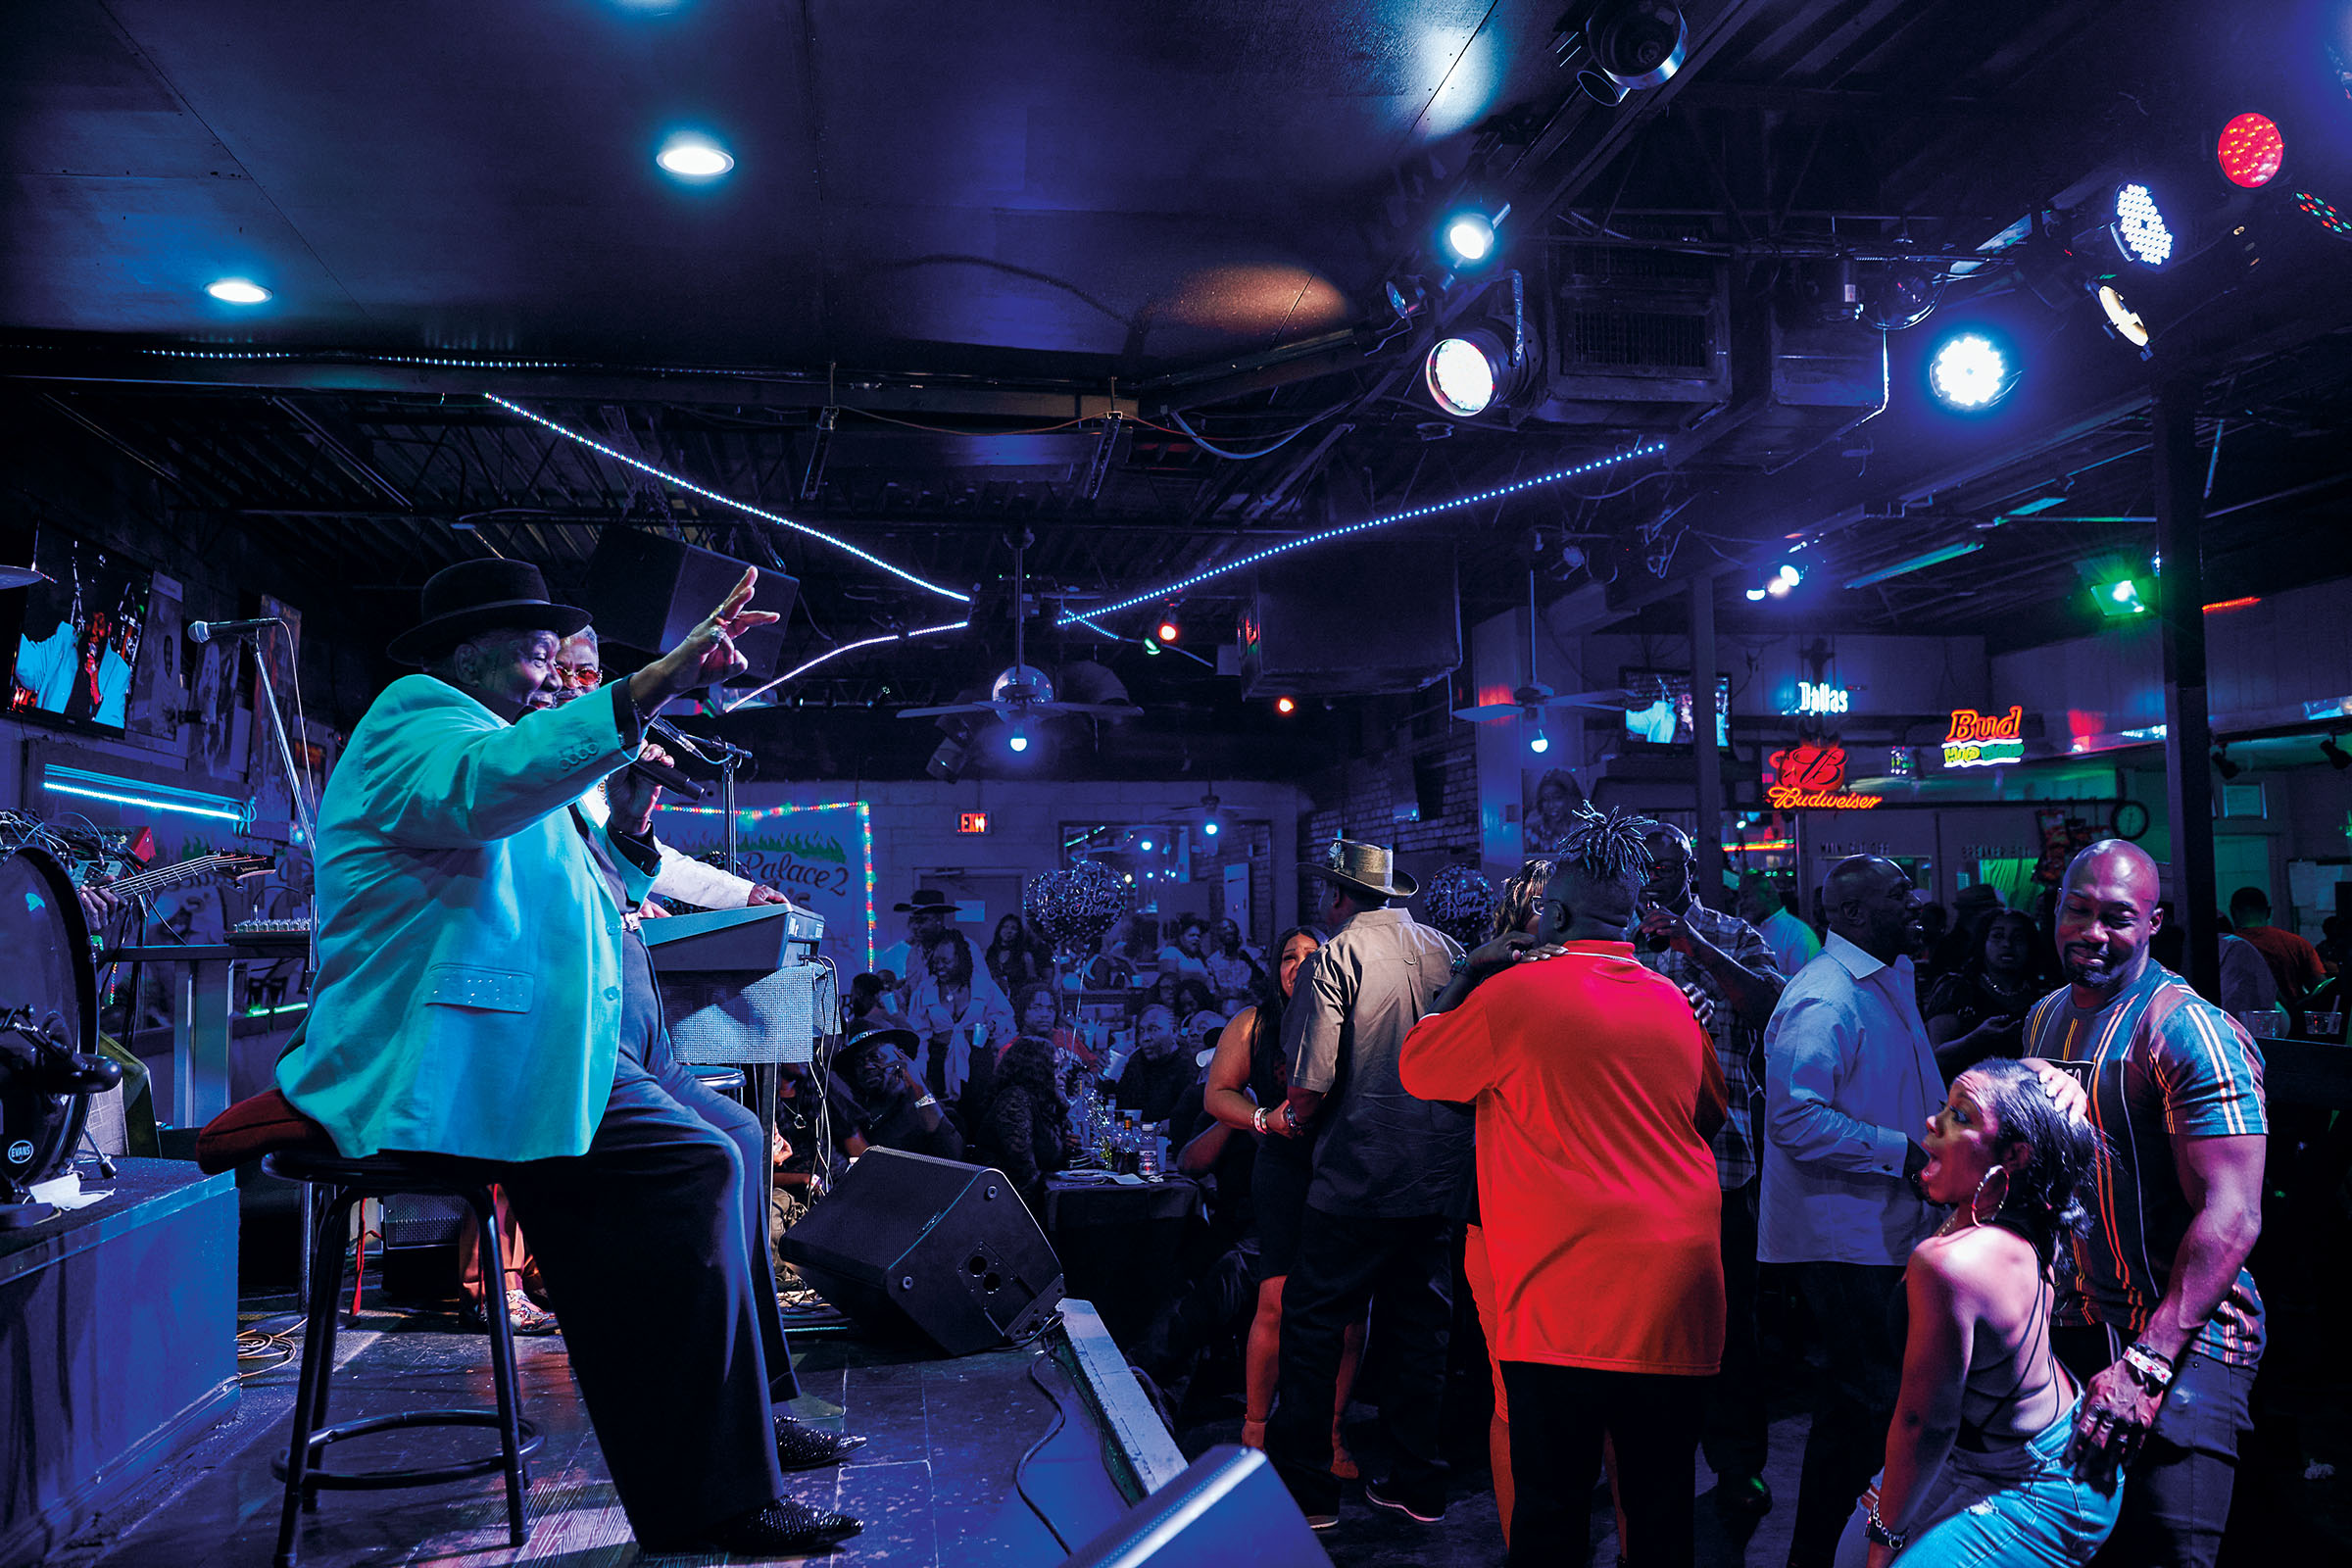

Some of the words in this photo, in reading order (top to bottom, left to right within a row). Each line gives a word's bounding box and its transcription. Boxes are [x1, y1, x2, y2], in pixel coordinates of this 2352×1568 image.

[1798, 682, 1848, 712] Dallas
[1945, 706, 2023, 742] Bud
[1768, 787, 1883, 808] Budweiser
[745, 851, 831, 889] Palace
[829, 866, 849, 897] 2
[11, 1146, 30, 1157] EVANS
